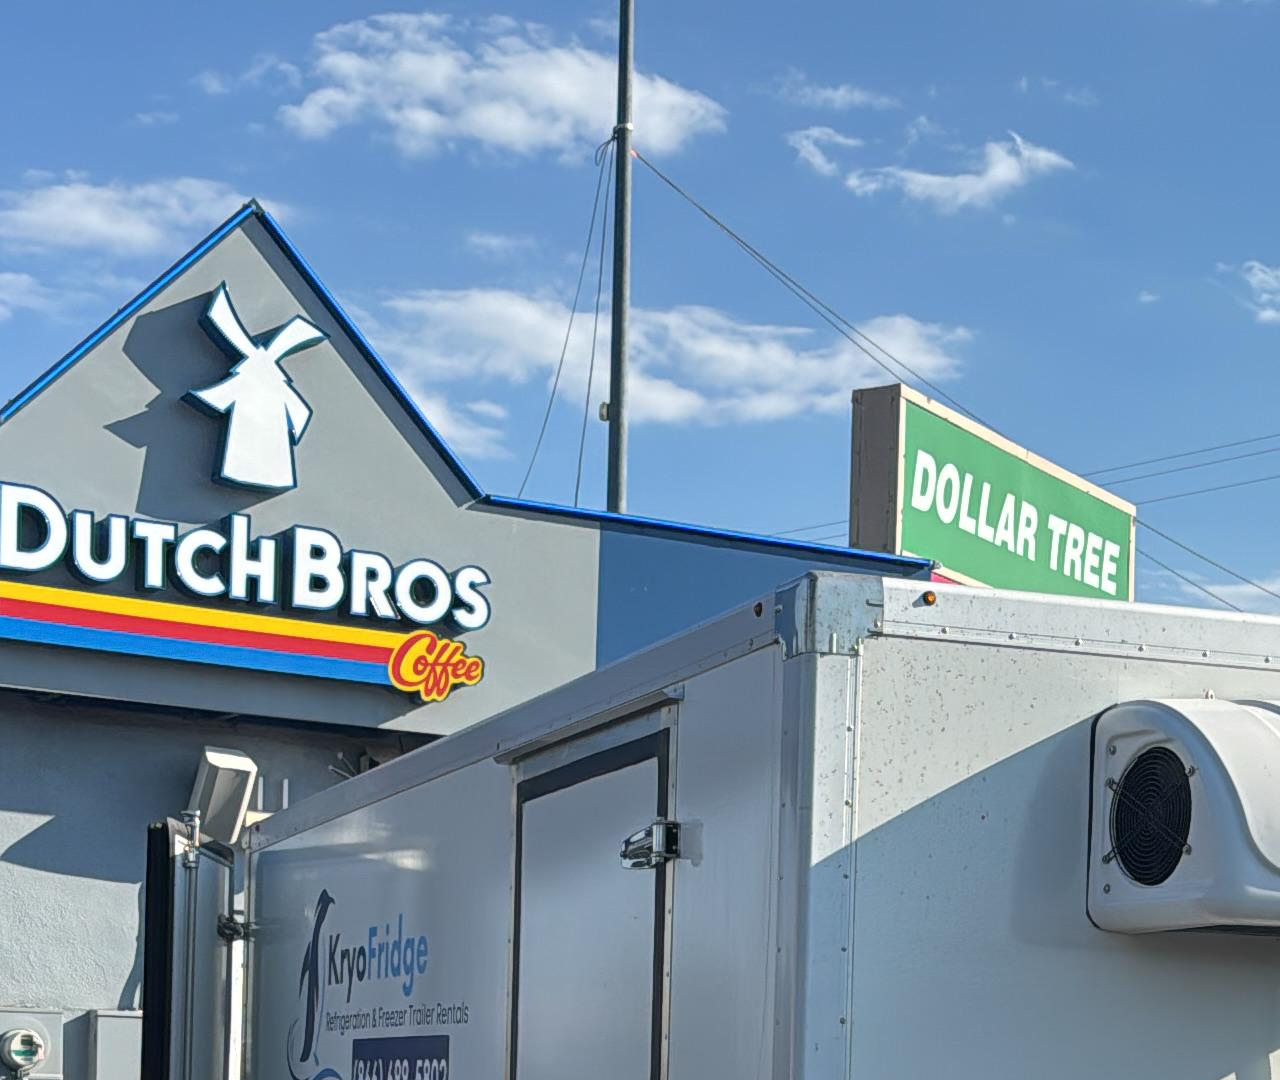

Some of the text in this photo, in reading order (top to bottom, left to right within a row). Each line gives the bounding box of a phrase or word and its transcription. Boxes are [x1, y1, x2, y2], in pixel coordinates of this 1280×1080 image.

[911, 449, 1121, 596] DOLLAR TREE
[291, 525, 492, 631] BROS
[391, 632, 481, 698] Coffee
[327, 912, 429, 1004] KryoFridge
[325, 1001, 469, 1036] Refrigeration & Freezer Trailer Rentals
